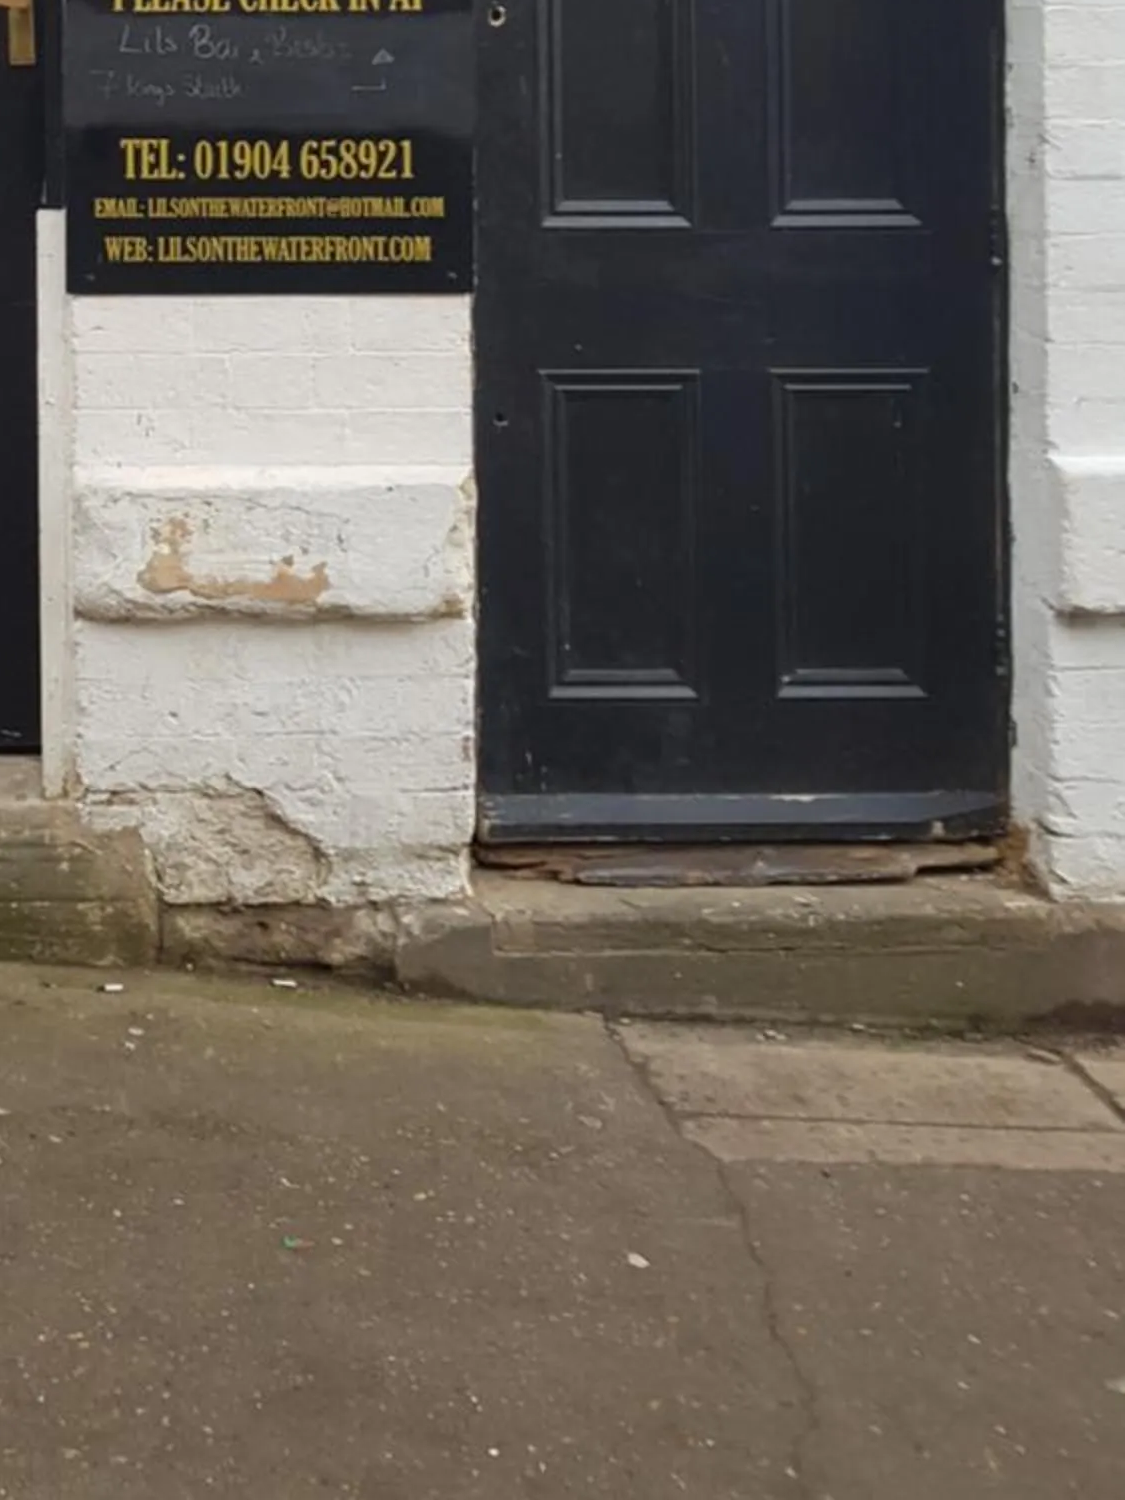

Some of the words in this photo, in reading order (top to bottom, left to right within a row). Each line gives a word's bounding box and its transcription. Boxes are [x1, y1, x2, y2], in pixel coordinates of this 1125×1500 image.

[119, 138, 186, 179] TEL:
[194, 140, 291, 180] 01904
[300, 139, 414, 179] 658921
[148, 197, 444, 218] LILSONTHEWATERFRONT@HOTMAIL.COM
[104, 236, 153, 262] WEB:
[158, 235, 431, 262] LILSONTHEWATERFRONT.COM
